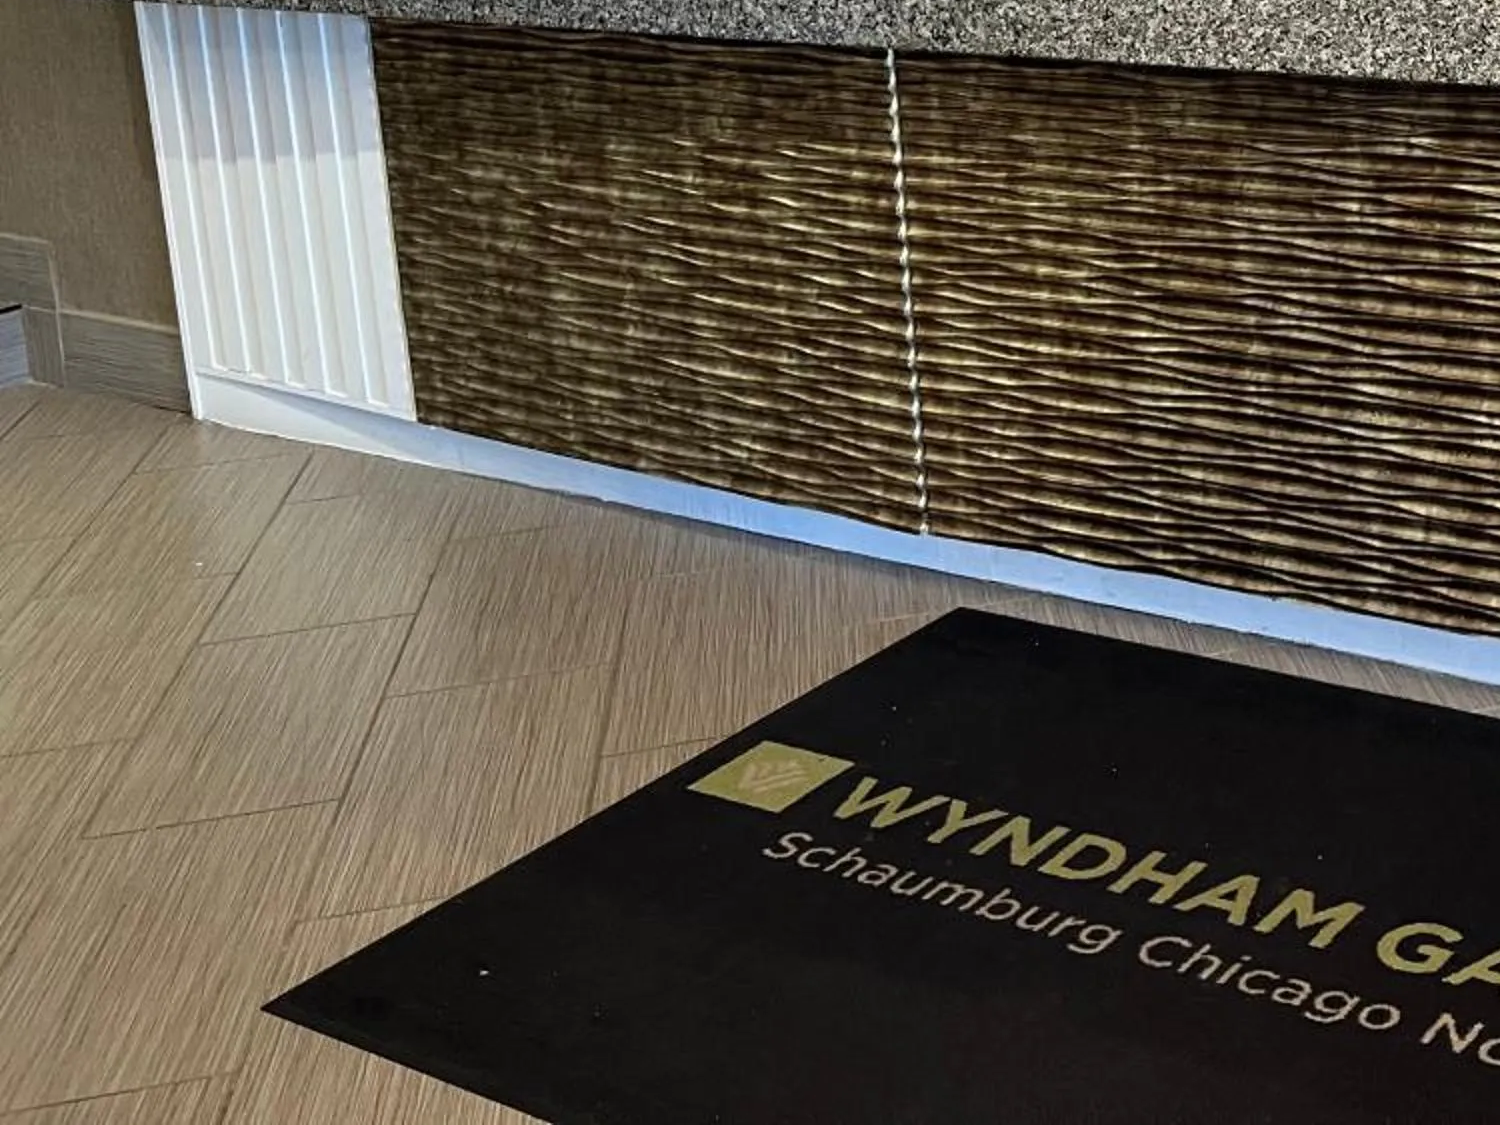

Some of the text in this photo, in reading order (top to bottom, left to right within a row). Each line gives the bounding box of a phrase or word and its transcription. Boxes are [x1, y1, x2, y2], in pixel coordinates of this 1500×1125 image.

[762, 831, 1125, 954] Schaumburg
[1138, 935, 1401, 1030] Chicago
[833, 777, 1366, 949] WYNDHAM
